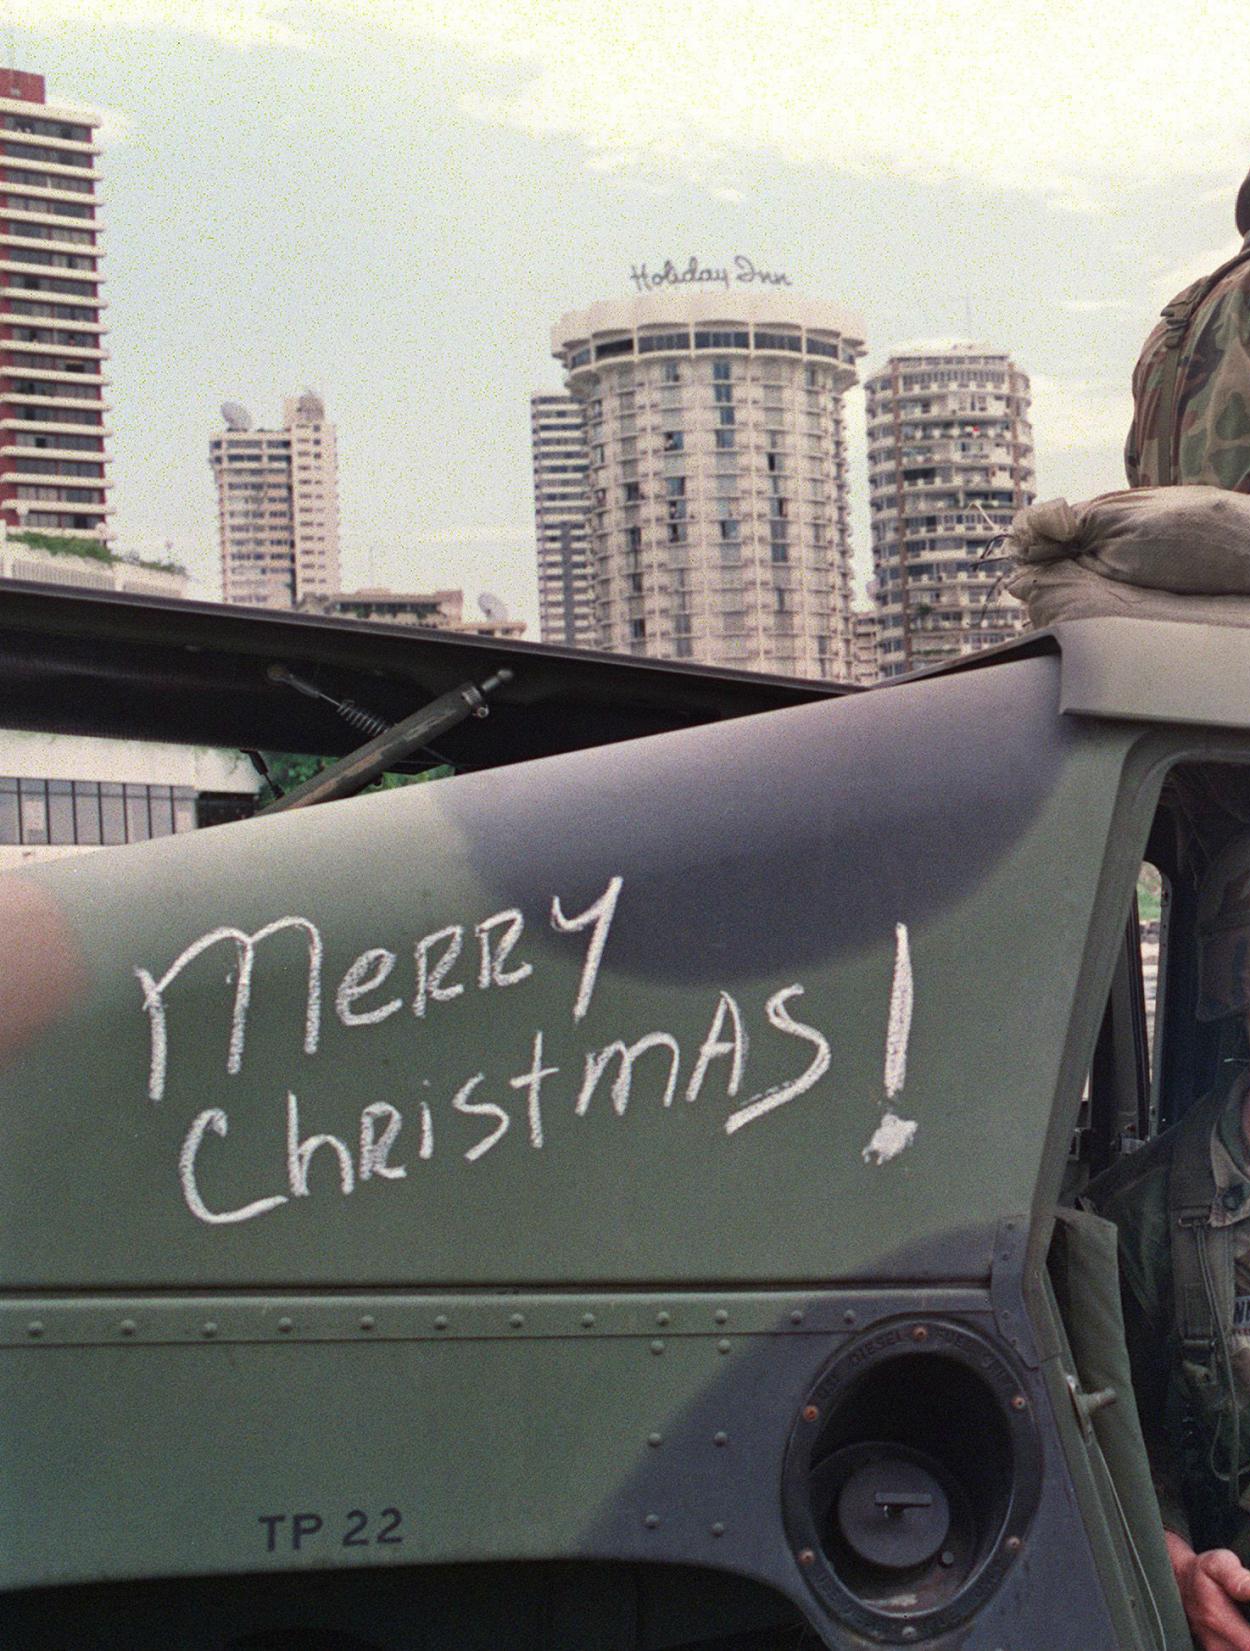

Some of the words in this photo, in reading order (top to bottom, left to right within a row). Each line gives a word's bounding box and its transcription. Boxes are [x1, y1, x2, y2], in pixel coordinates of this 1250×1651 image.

[630, 256, 730, 291] Holiday
[734, 254, 792, 286] Inn
[257, 1513, 324, 1551] TP
[341, 1507, 403, 1547] 22
